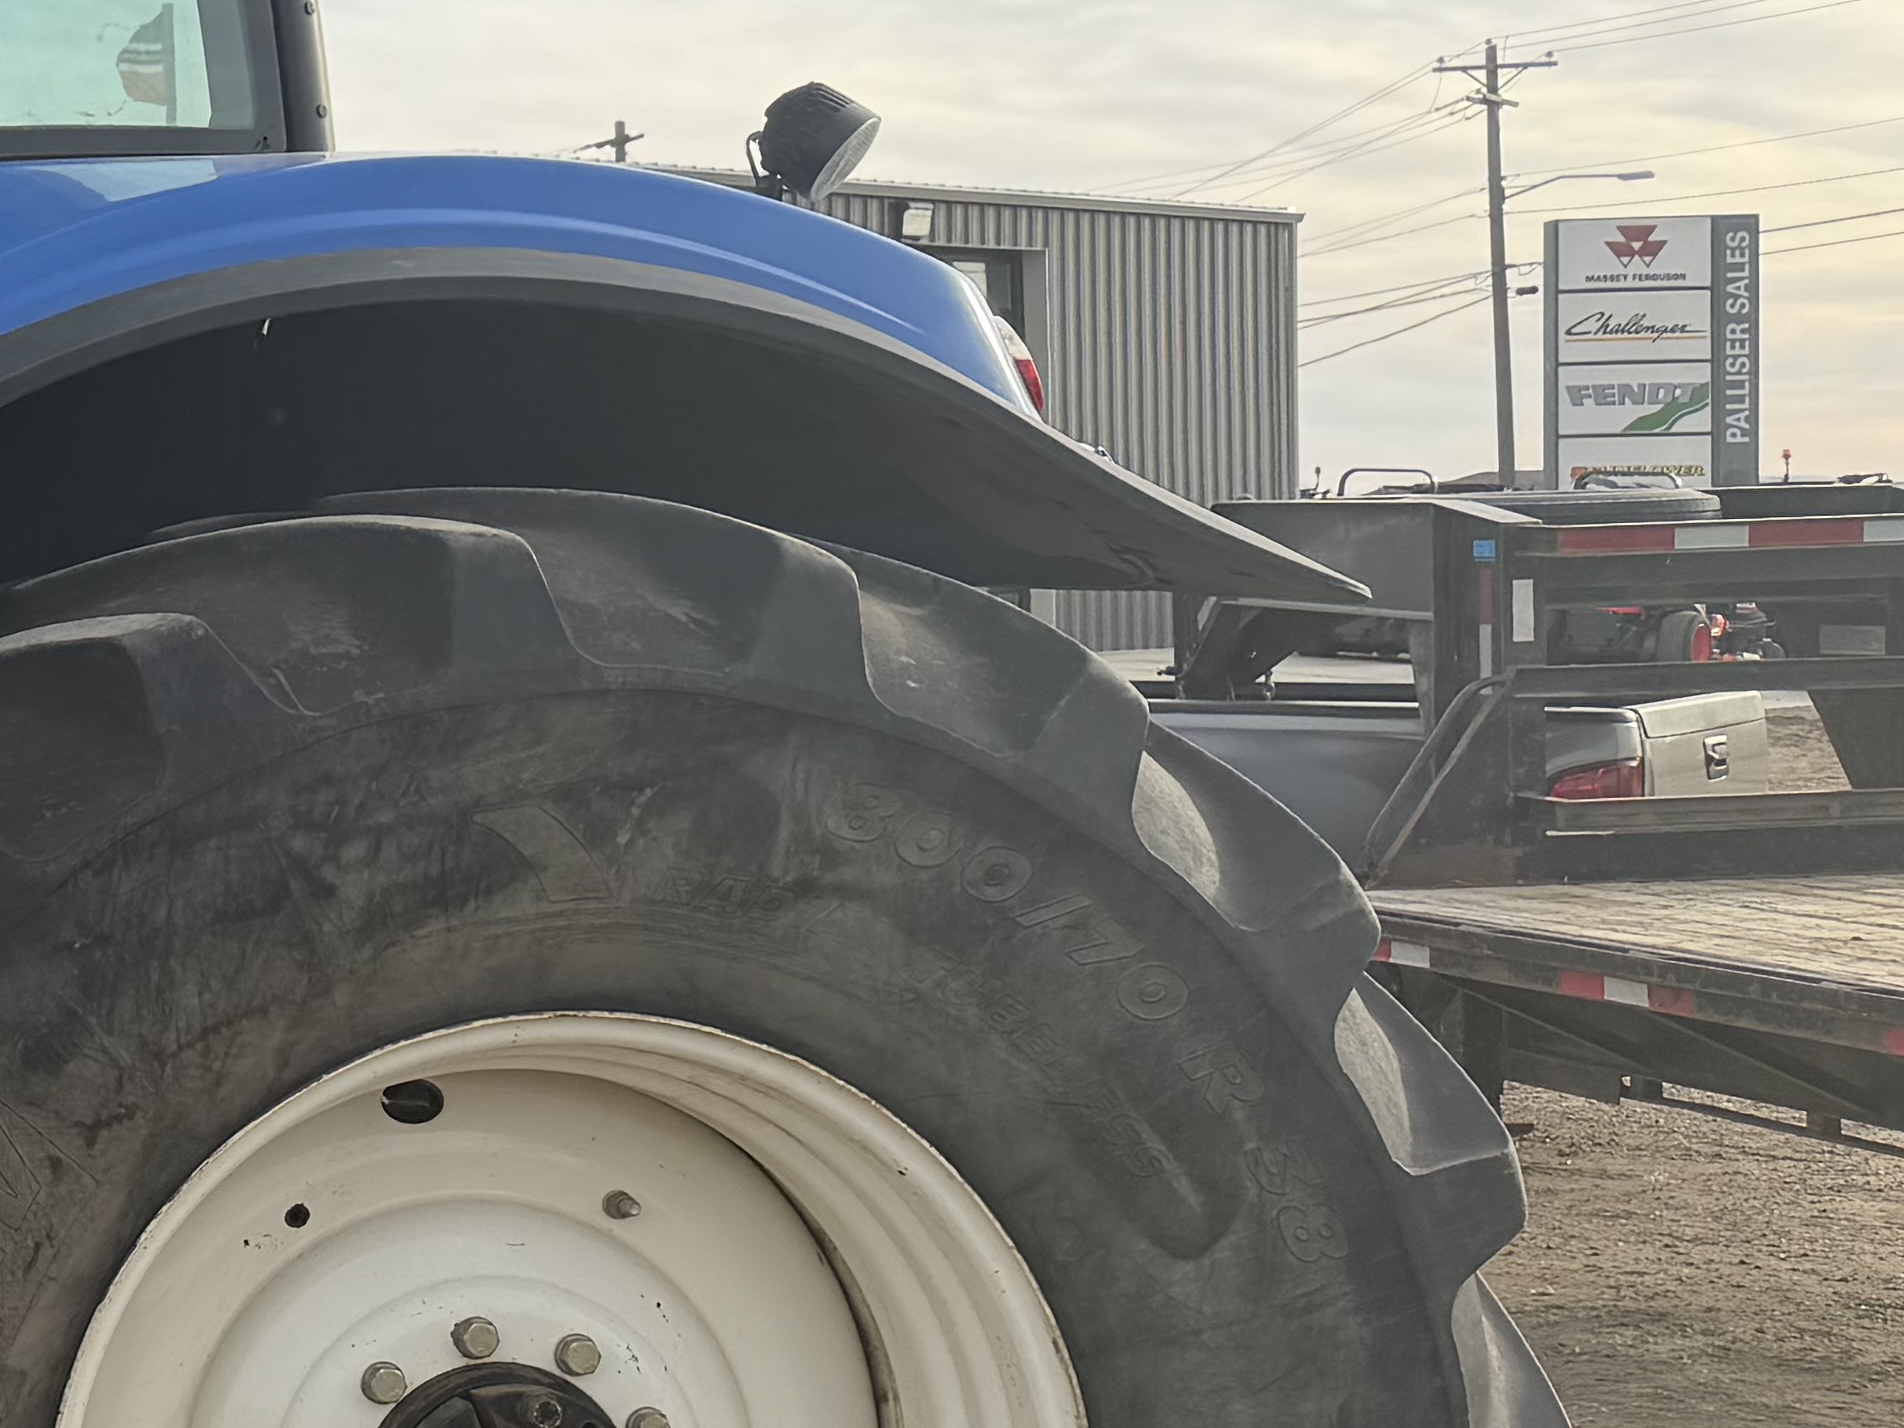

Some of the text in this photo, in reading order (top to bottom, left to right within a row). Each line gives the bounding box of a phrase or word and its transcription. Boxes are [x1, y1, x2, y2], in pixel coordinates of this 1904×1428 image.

[1584, 272, 1687, 283] MASSEY FERGUSON
[1564, 311, 1708, 343] Challenger
[1725, 230, 1750, 443] PALLISER SALES
[1565, 382, 1702, 407] FENDT
[825, 782, 1190, 1022] 800/70
